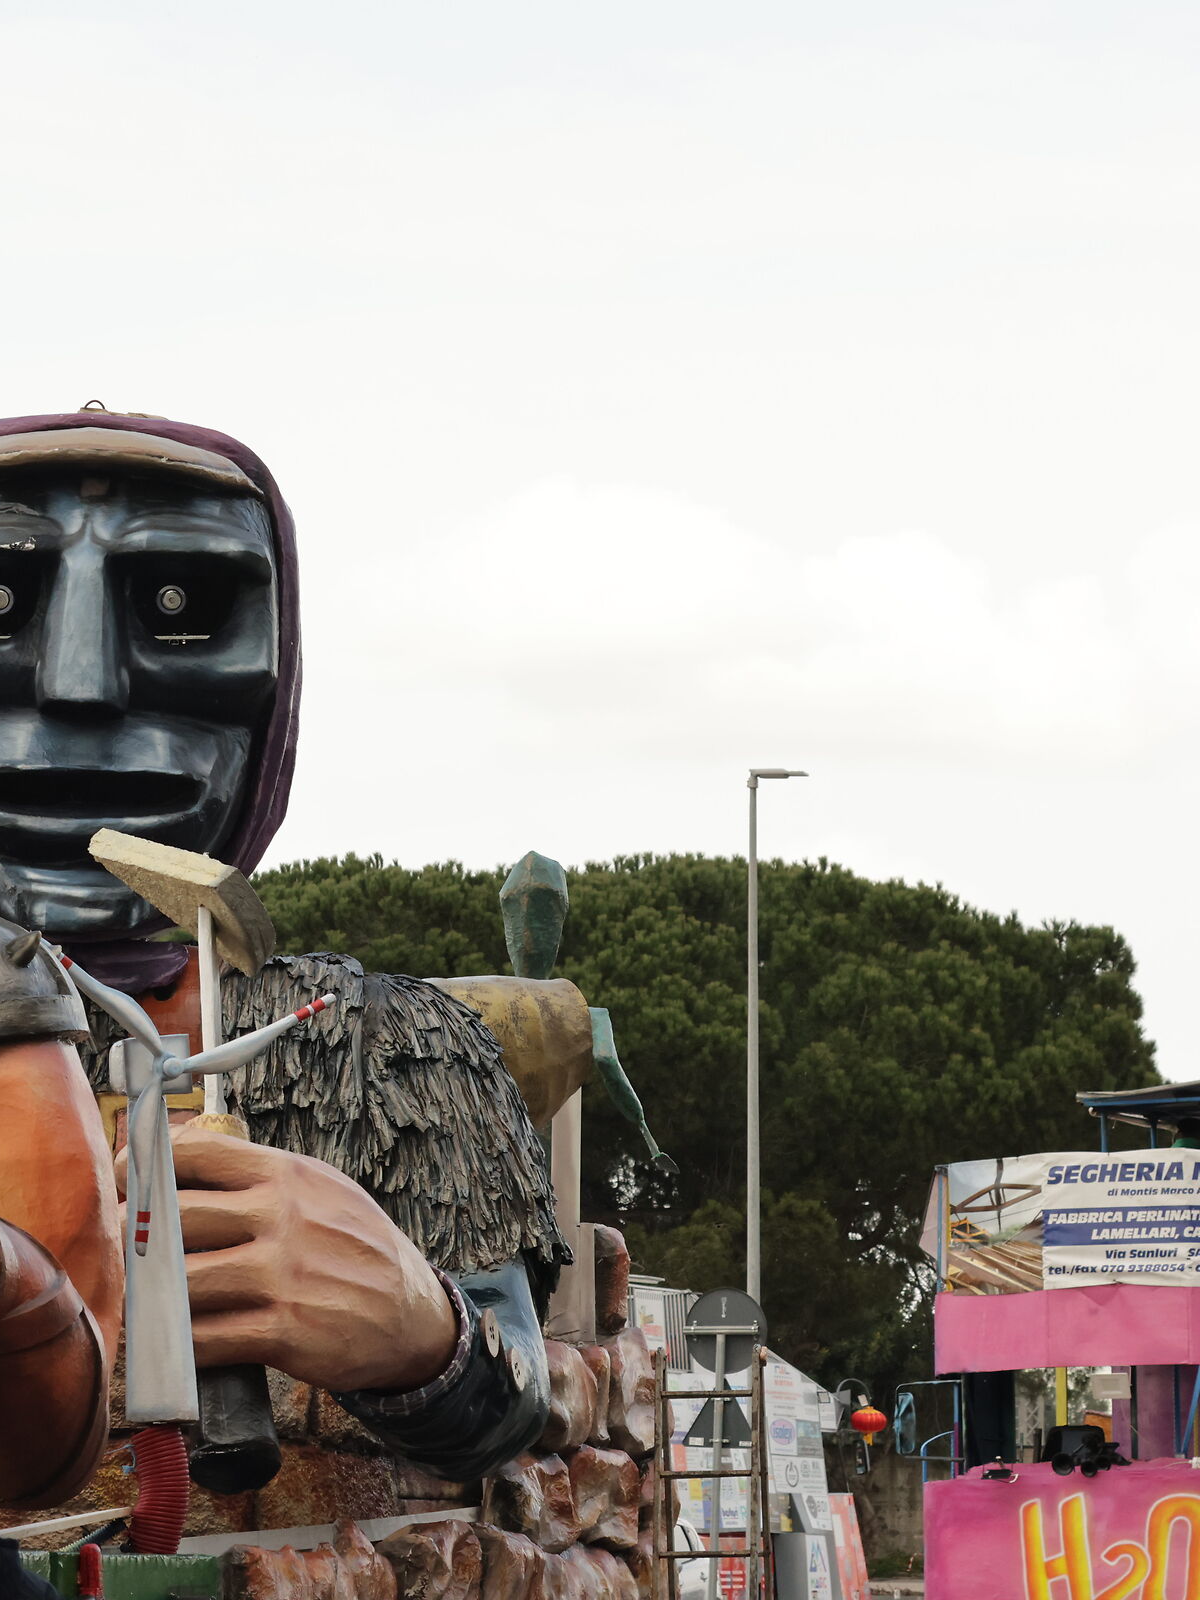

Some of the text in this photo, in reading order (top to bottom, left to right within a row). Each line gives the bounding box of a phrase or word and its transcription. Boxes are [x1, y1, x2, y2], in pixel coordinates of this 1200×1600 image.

[1047, 1162, 1184, 1185] SEGHERIA
[1107, 1188, 1118, 1196] di
[1120, 1187, 1158, 1196] Montis
[1160, 1187, 1195, 1195] Marco
[1048, 1211, 1123, 1224] FABBRICA
[1091, 1227, 1180, 1240] LAMELLARI,
[1105, 1249, 1127, 1259] Via
[1129, 1248, 1178, 1258] Sanluri
[1048, 1265, 1098, 1275] tel./fax
[1100, 1264, 1125, 1273] 070
